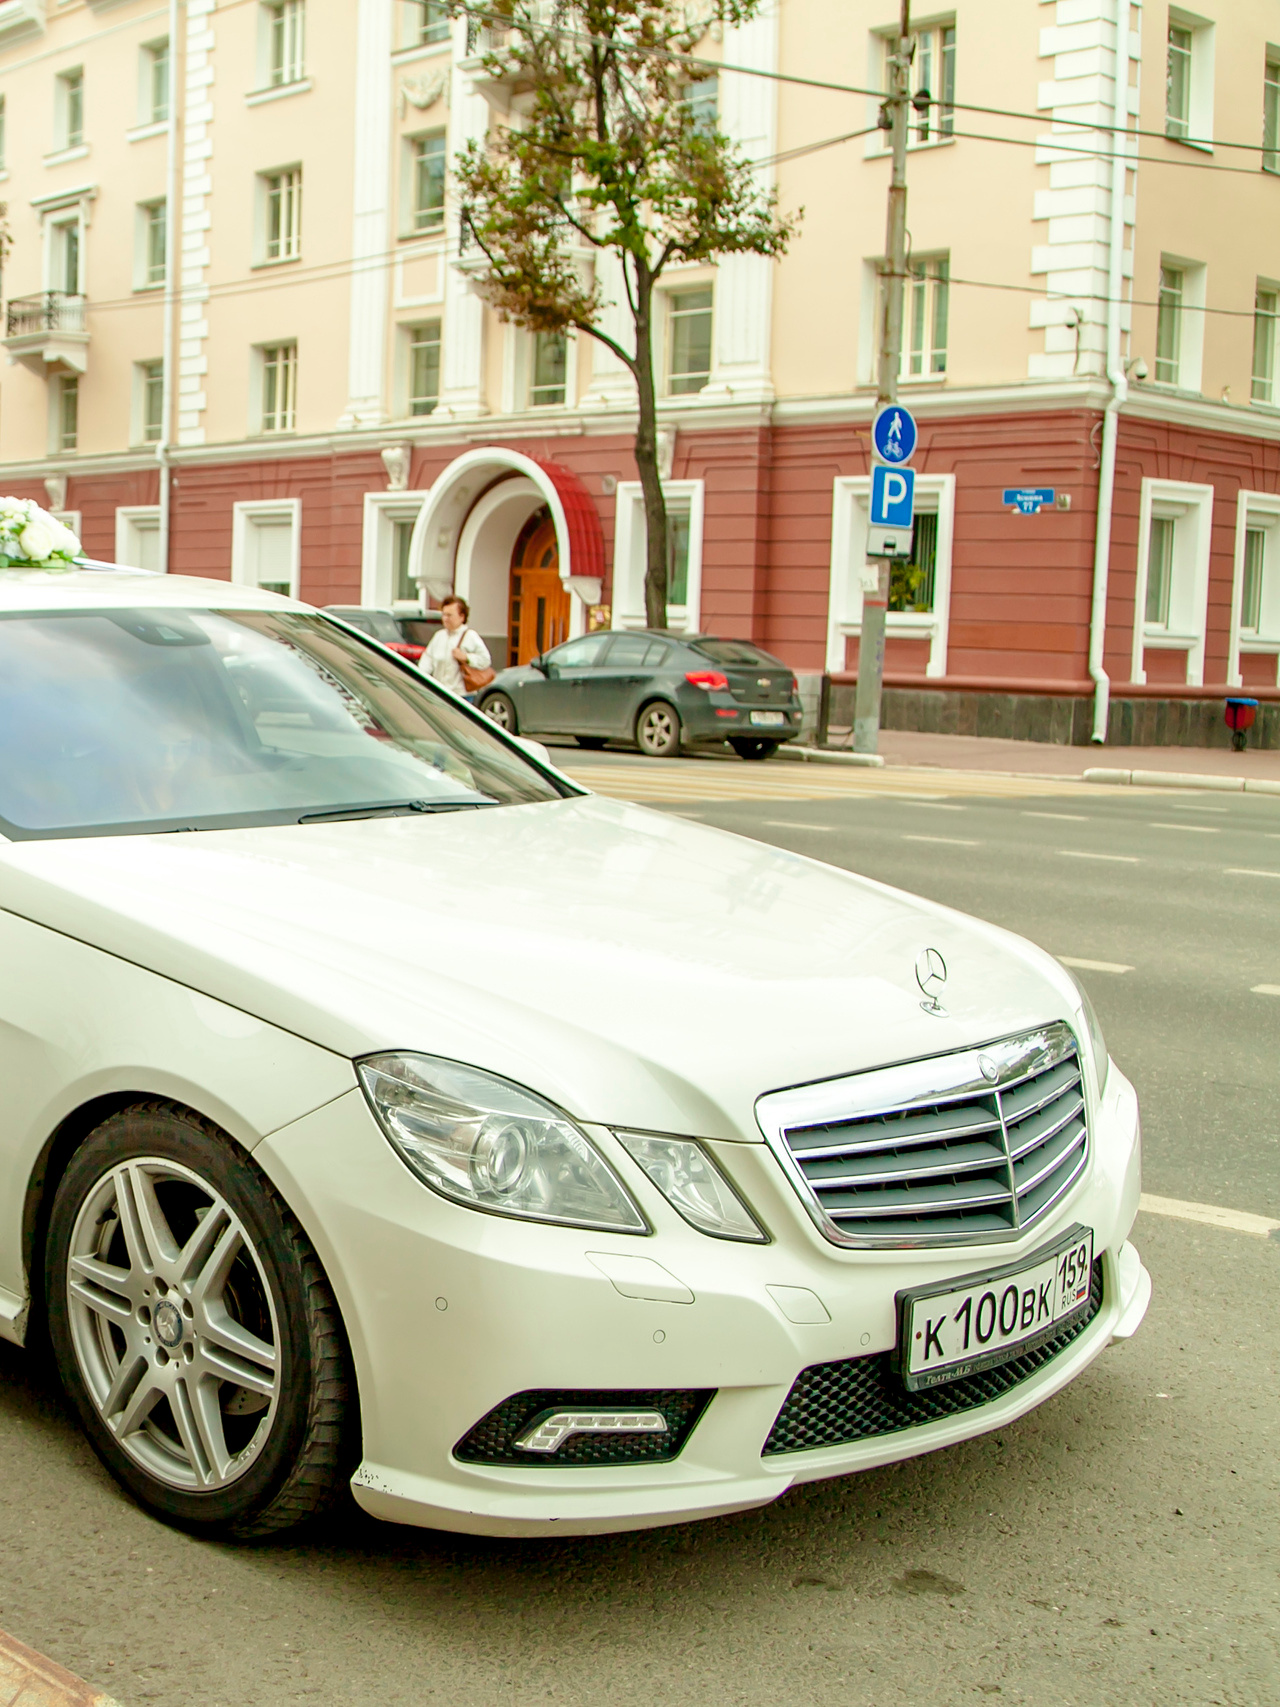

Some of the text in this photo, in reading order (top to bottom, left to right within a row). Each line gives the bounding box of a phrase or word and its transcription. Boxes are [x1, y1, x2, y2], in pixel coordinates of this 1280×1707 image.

[882, 472, 907, 519] P
[1058, 1243, 1087, 1293] 159
[1061, 1288, 1077, 1310] RUS
